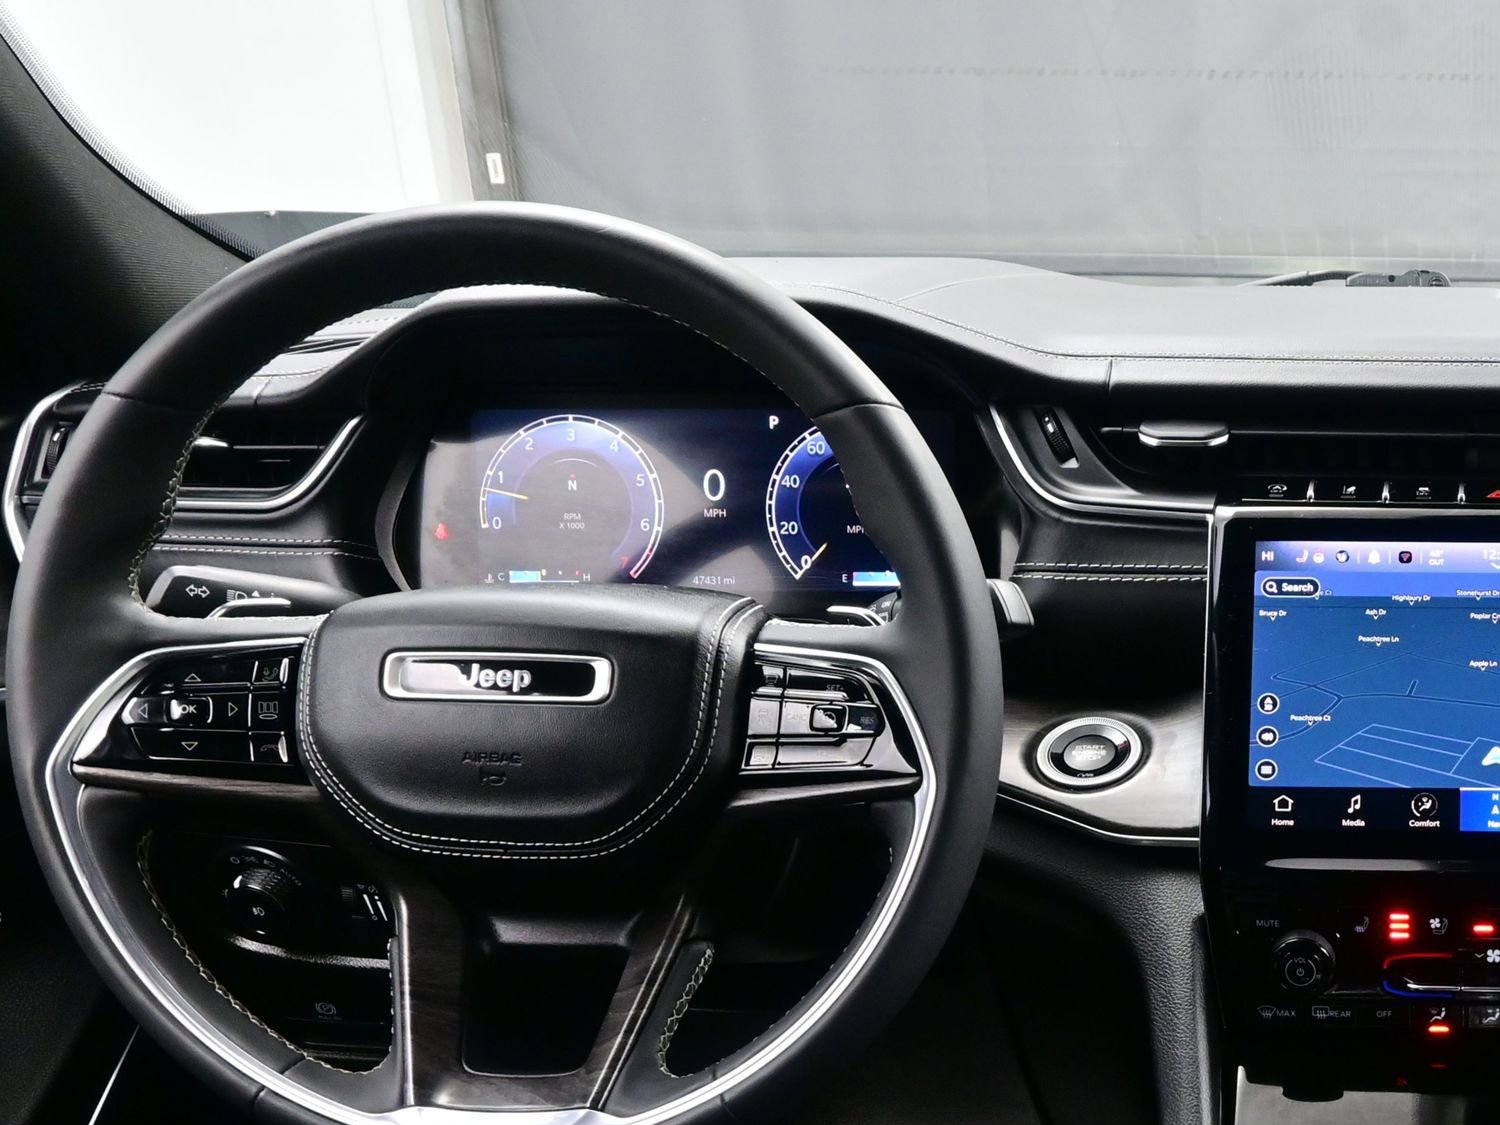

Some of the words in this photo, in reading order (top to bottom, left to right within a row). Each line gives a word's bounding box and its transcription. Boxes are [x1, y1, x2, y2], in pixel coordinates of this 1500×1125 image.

[768, 415, 779, 429] P
[567, 429, 575, 441] 3
[525, 437, 534, 450] 2
[609, 440, 618, 453] 4
[806, 441, 826, 455] 60
[497, 471, 504, 484] 1
[636, 474, 645, 487] 5
[781, 475, 800, 488] 40
[567, 480, 577, 491] N
[703, 469, 726, 501] 0
[563, 512, 581, 521] RPM
[703, 509, 727, 518] MPH
[492, 517, 502, 529] 0
[640, 518, 650, 531] 6
[780, 521, 798, 535] 20
[1261, 551, 1274, 561] HI
[621, 556, 629, 568] 7
[801, 555, 812, 569] 0
[1429, 558, 1445, 566] OUT
[498, 573, 505, 581] C
[583, 573, 591, 581] H
[692, 575, 721, 585] 47431
[723, 576, 735, 585] mi
[842, 574, 848, 583] E
[1281, 581, 1314, 593] Search
[1456, 589, 1491, 597] Stonehurst
[1392, 594, 1421, 604] Highbury
[1259, 609, 1277, 617] Bruce
[1470, 613, 1490, 621] Poplar
[1358, 635, 1389, 643] Peachtree
[1390, 635, 1399, 643] Ln
[1469, 660, 1487, 668] Apple
[462, 663, 531, 692] Jeep
[180, 703, 197, 714] OK
[859, 715, 875, 725] RES
[1290, 714, 1322, 722] Peachtree
[1323, 714, 1331, 722] Ct
[462, 751, 523, 766] AIRBAG
[1271, 818, 1295, 827] Home
[1342, 818, 1365, 827] Media
[1408, 819, 1441, 828] Comfort
[1256, 919, 1280, 928] MUTE
[1293, 957, 1307, 965] VOL
[1276, 1009, 1296, 1018] MAX
[1329, 1010, 1351, 1018] REAR
[1376, 1010, 1393, 1018] OFF
